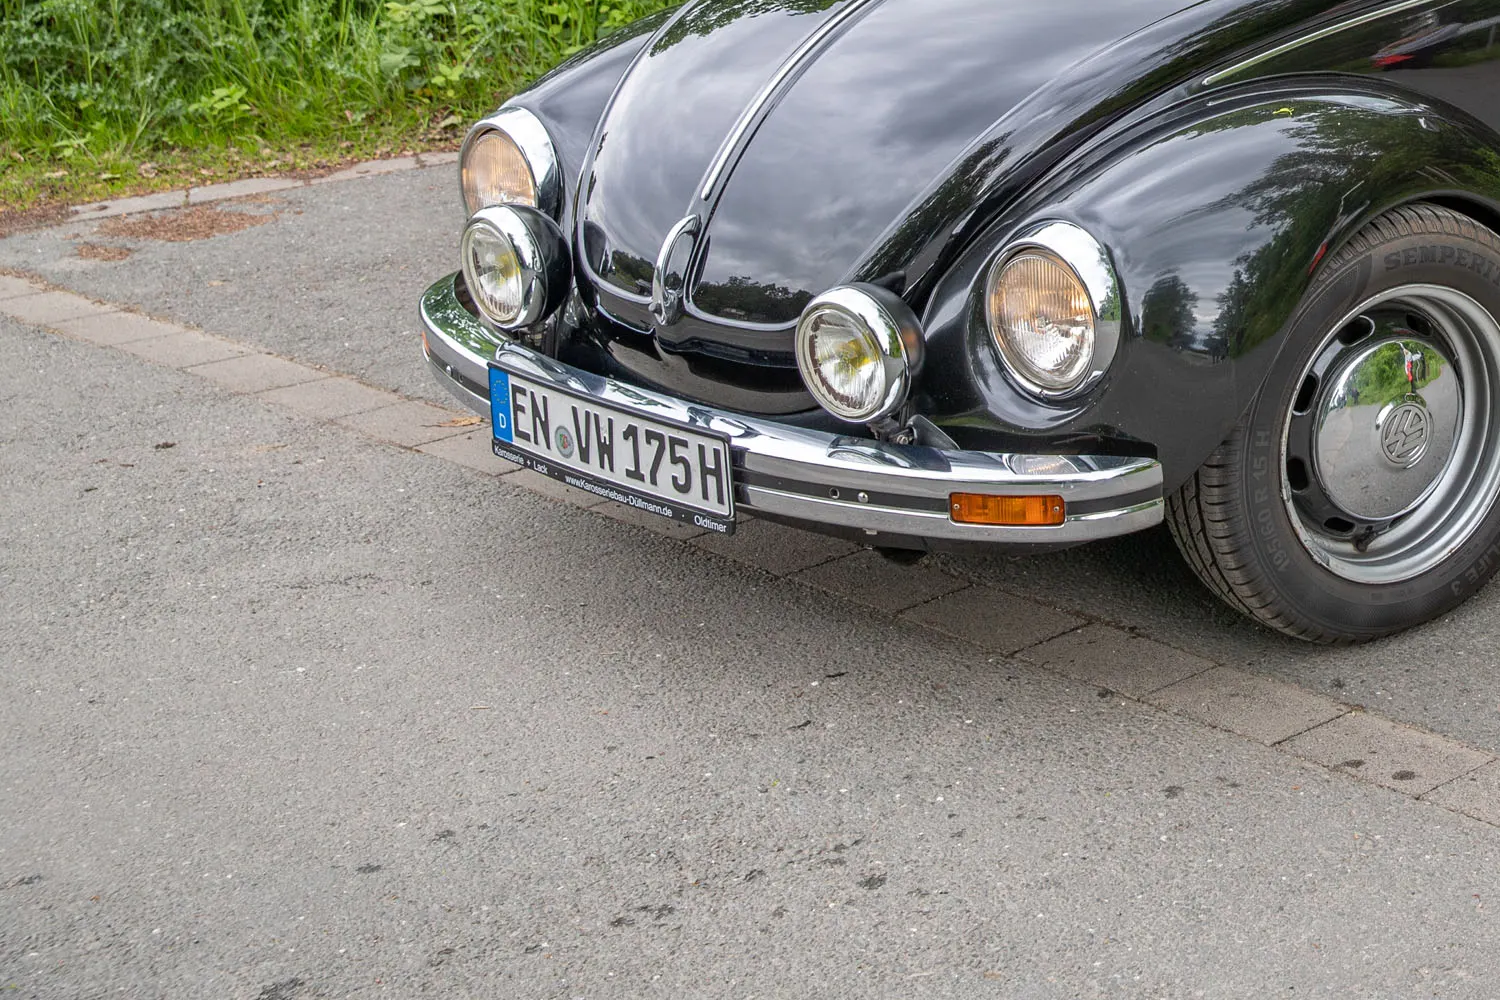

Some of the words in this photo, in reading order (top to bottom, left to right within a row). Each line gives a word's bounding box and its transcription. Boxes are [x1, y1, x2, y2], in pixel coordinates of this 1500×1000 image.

[499, 413, 507, 429] D
[511, 384, 551, 450] EN
[572, 405, 615, 472] VW
[494, 446, 525, 466] Karosserie
[533, 460, 548, 475] Lack
[1253, 456, 1268, 480] 15
[1254, 486, 1269, 504] R
[694, 514, 727, 534] Oldtimer
[1256, 507, 1291, 572] 195/60
